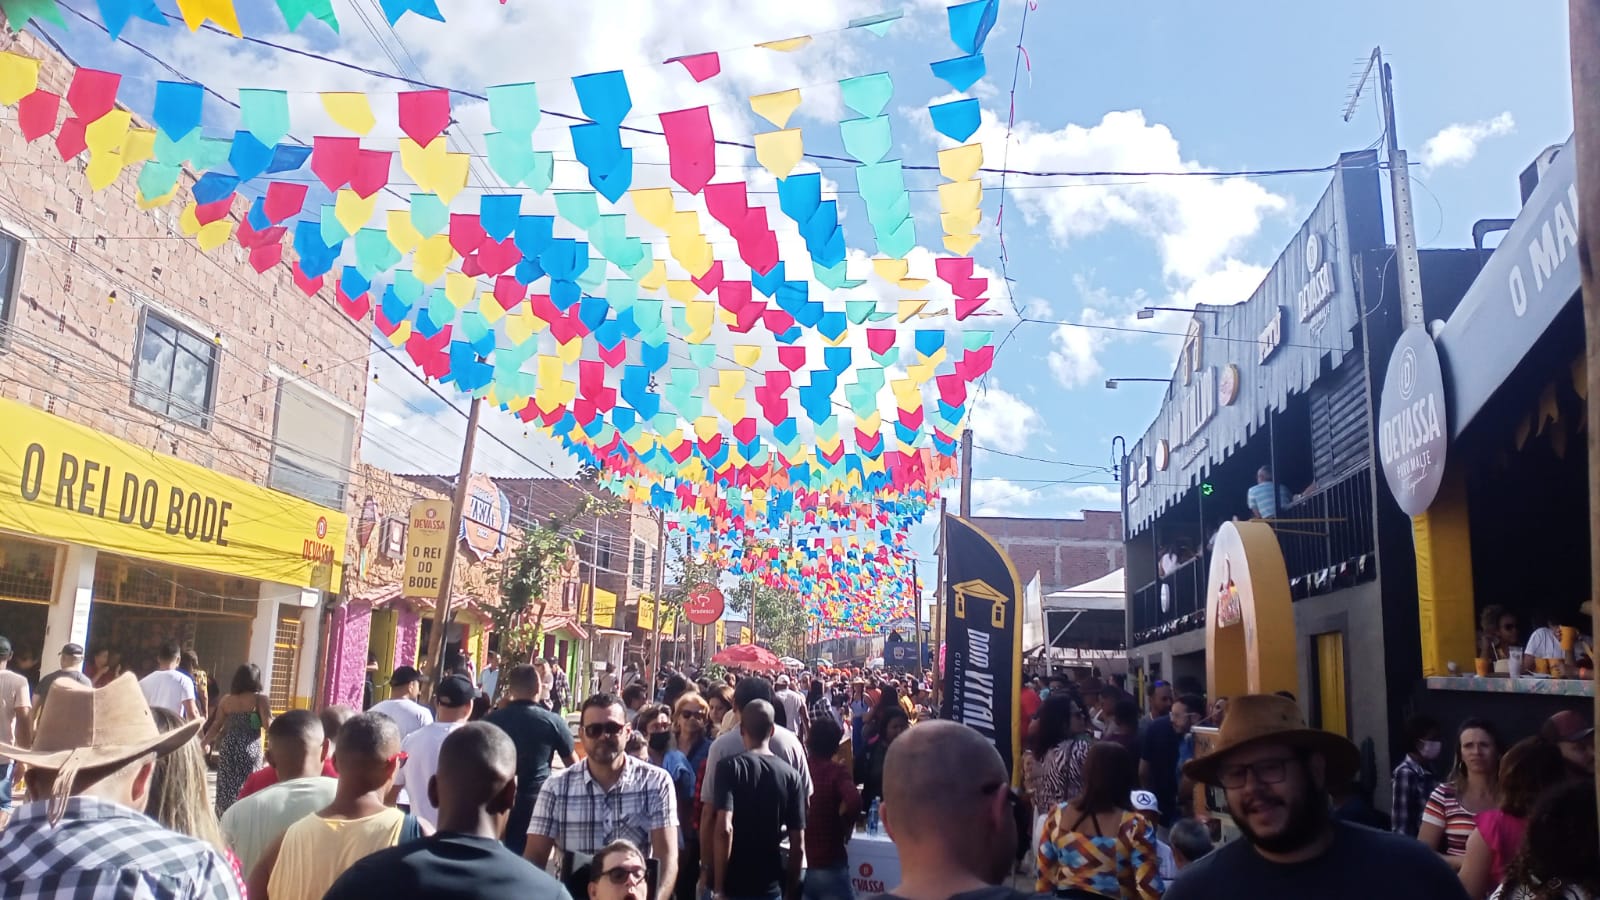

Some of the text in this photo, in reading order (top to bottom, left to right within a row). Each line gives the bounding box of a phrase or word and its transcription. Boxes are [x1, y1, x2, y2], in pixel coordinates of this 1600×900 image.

[1508, 264, 1528, 318] O
[1383, 392, 1441, 465] DEVASSA
[1409, 450, 1431, 472] MALTE
[20, 443, 233, 547] O REI DO BODE
[413, 518, 446, 530] DEVASSA
[302, 539, 335, 564] DEVASSA
[412, 546, 441, 559] O REI
[418, 561, 433, 573] DO
[408, 576, 438, 589] BODE
[953, 652, 961, 702] CULTURA
[963, 628, 996, 745] DOM VITAL
[852, 878, 885, 893] EVASSA
